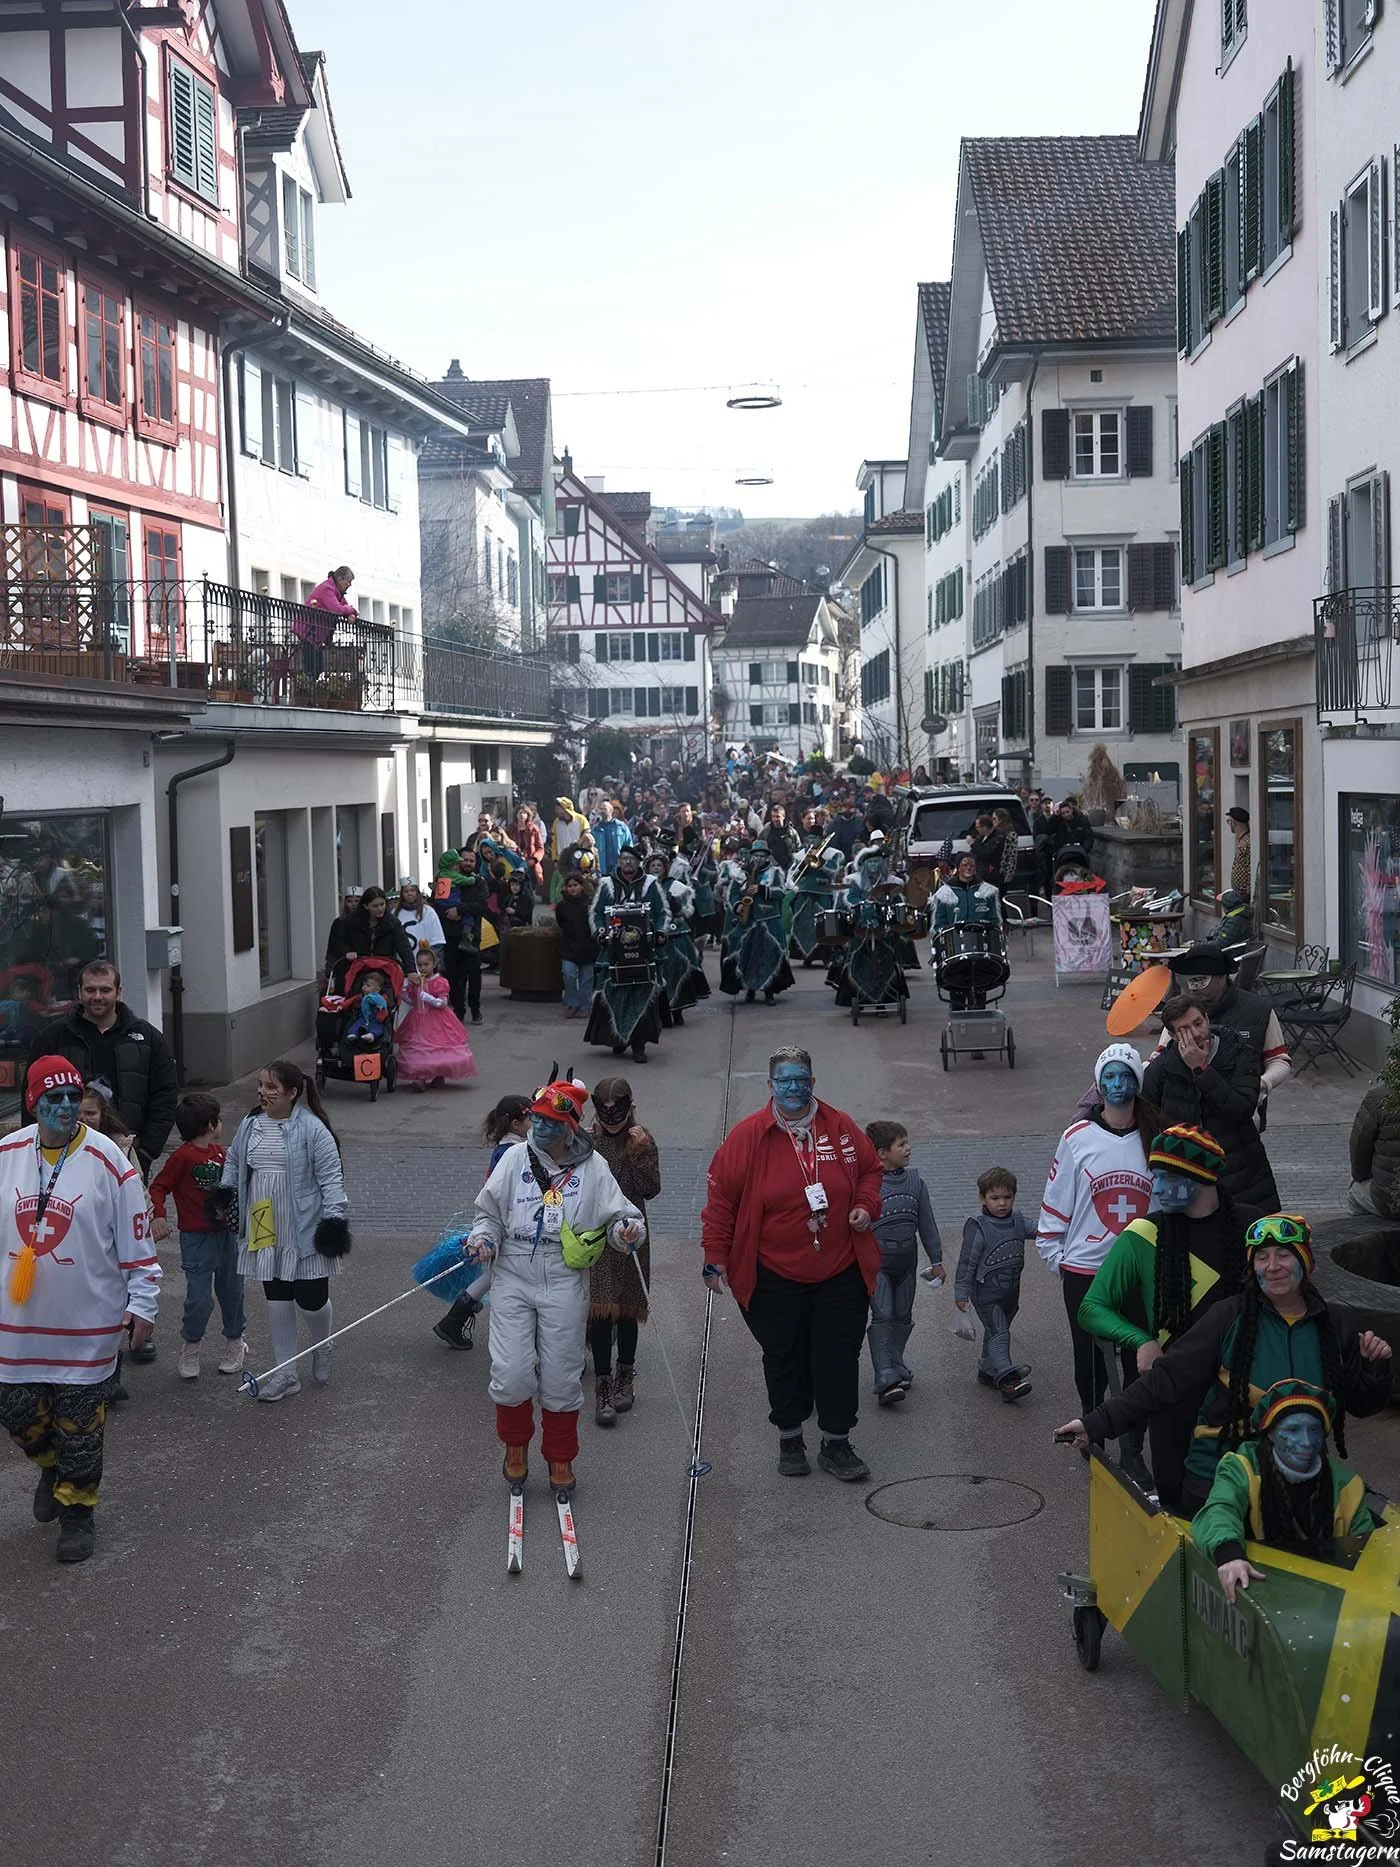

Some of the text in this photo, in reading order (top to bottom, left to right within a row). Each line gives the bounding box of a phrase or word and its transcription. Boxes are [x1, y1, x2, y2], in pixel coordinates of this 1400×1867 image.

[360, 1059, 373, 1077] C
[1092, 1174, 1151, 1194] SWITZERLAND
[17, 1198, 72, 1218] SWITRLAND
